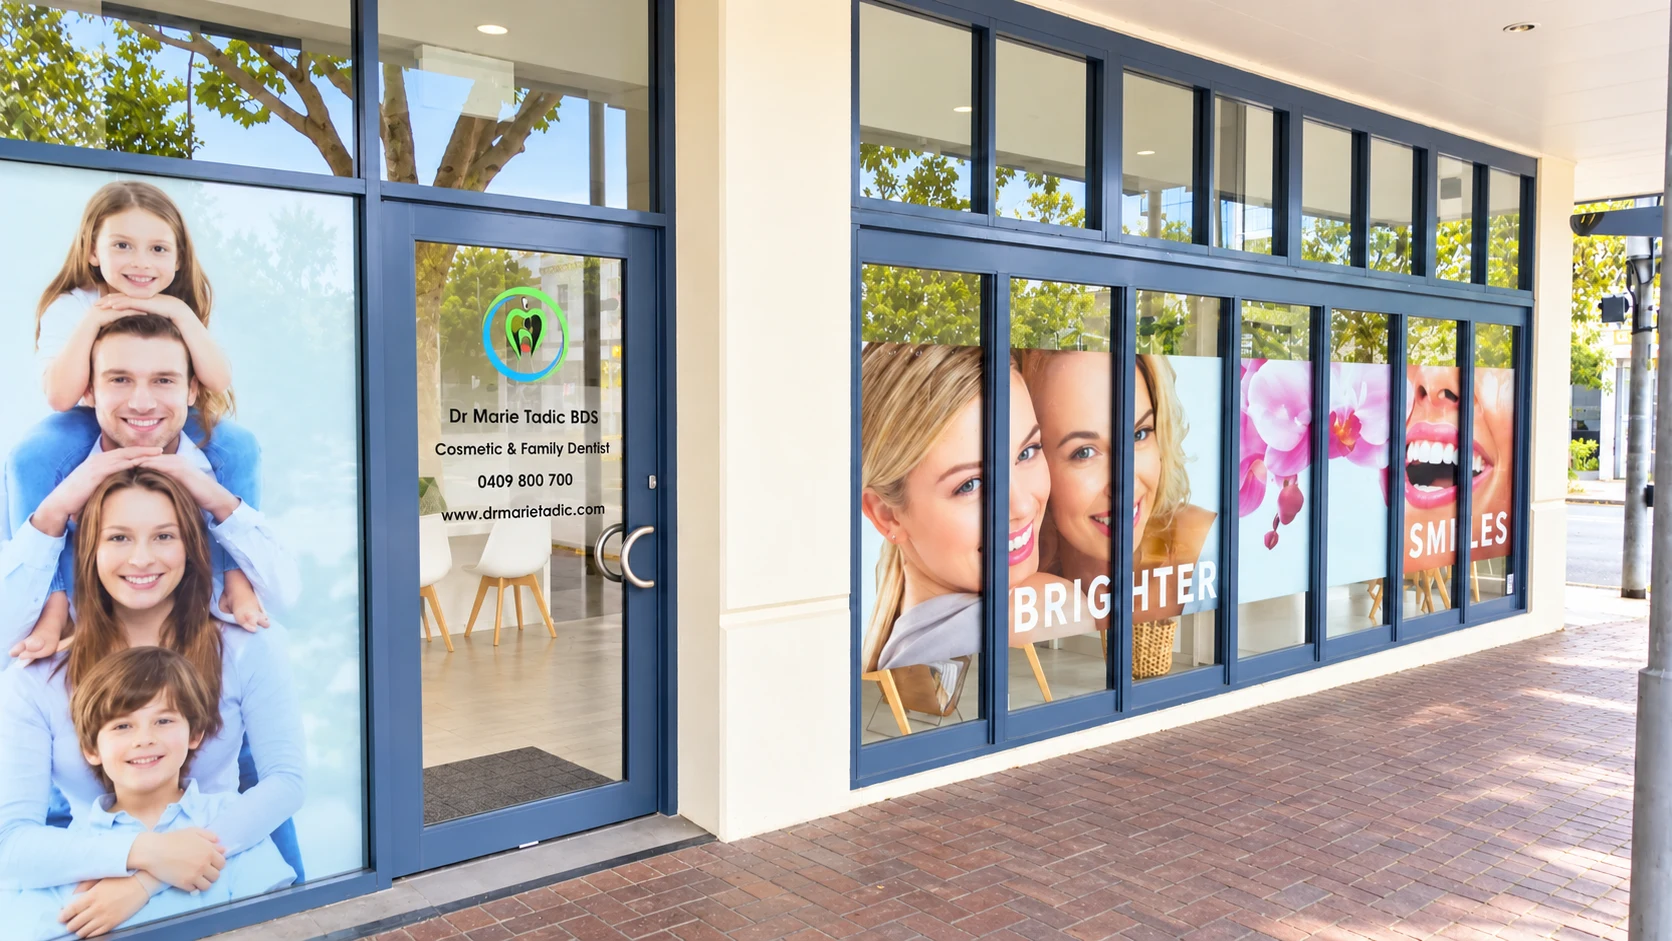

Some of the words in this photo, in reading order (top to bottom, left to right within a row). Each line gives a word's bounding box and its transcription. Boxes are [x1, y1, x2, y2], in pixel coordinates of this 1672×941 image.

[449, 408, 467, 423] Dr
[473, 409, 519, 424] Marie
[524, 409, 565, 424] Tadic
[570, 410, 598, 424] BDS
[435, 442, 502, 455] Cosmetic
[507, 442, 516, 455] &
[521, 442, 563, 457] Family
[568, 442, 610, 454] Dentist
[478, 475, 513, 488] 0409
[518, 474, 544, 487] 800
[548, 473, 573, 487] 700
[441, 504, 605, 521] www.drmarietadic.com
[1014, 560, 1217, 633] BRIGHTER
[1409, 511, 1508, 558] SMILES
